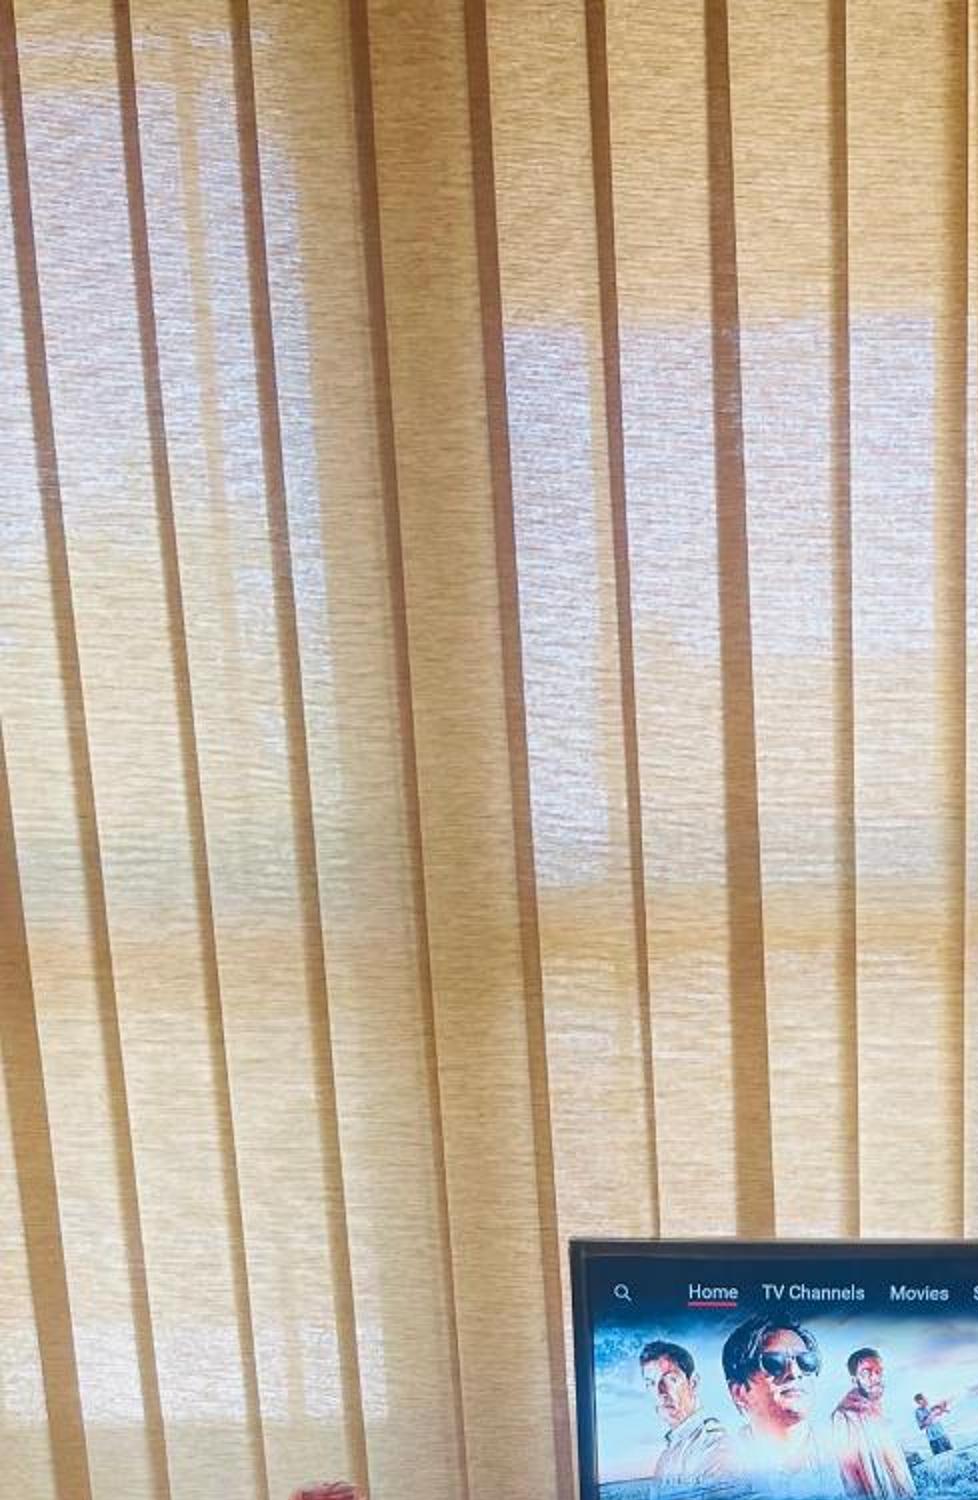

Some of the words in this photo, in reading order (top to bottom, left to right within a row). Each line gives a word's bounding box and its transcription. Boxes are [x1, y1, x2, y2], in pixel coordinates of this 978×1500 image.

[687, 1283, 739, 1300] Home
[762, 1284, 785, 1300] TV
[788, 1284, 866, 1301] Channels
[889, 1285, 950, 1301] Movies
